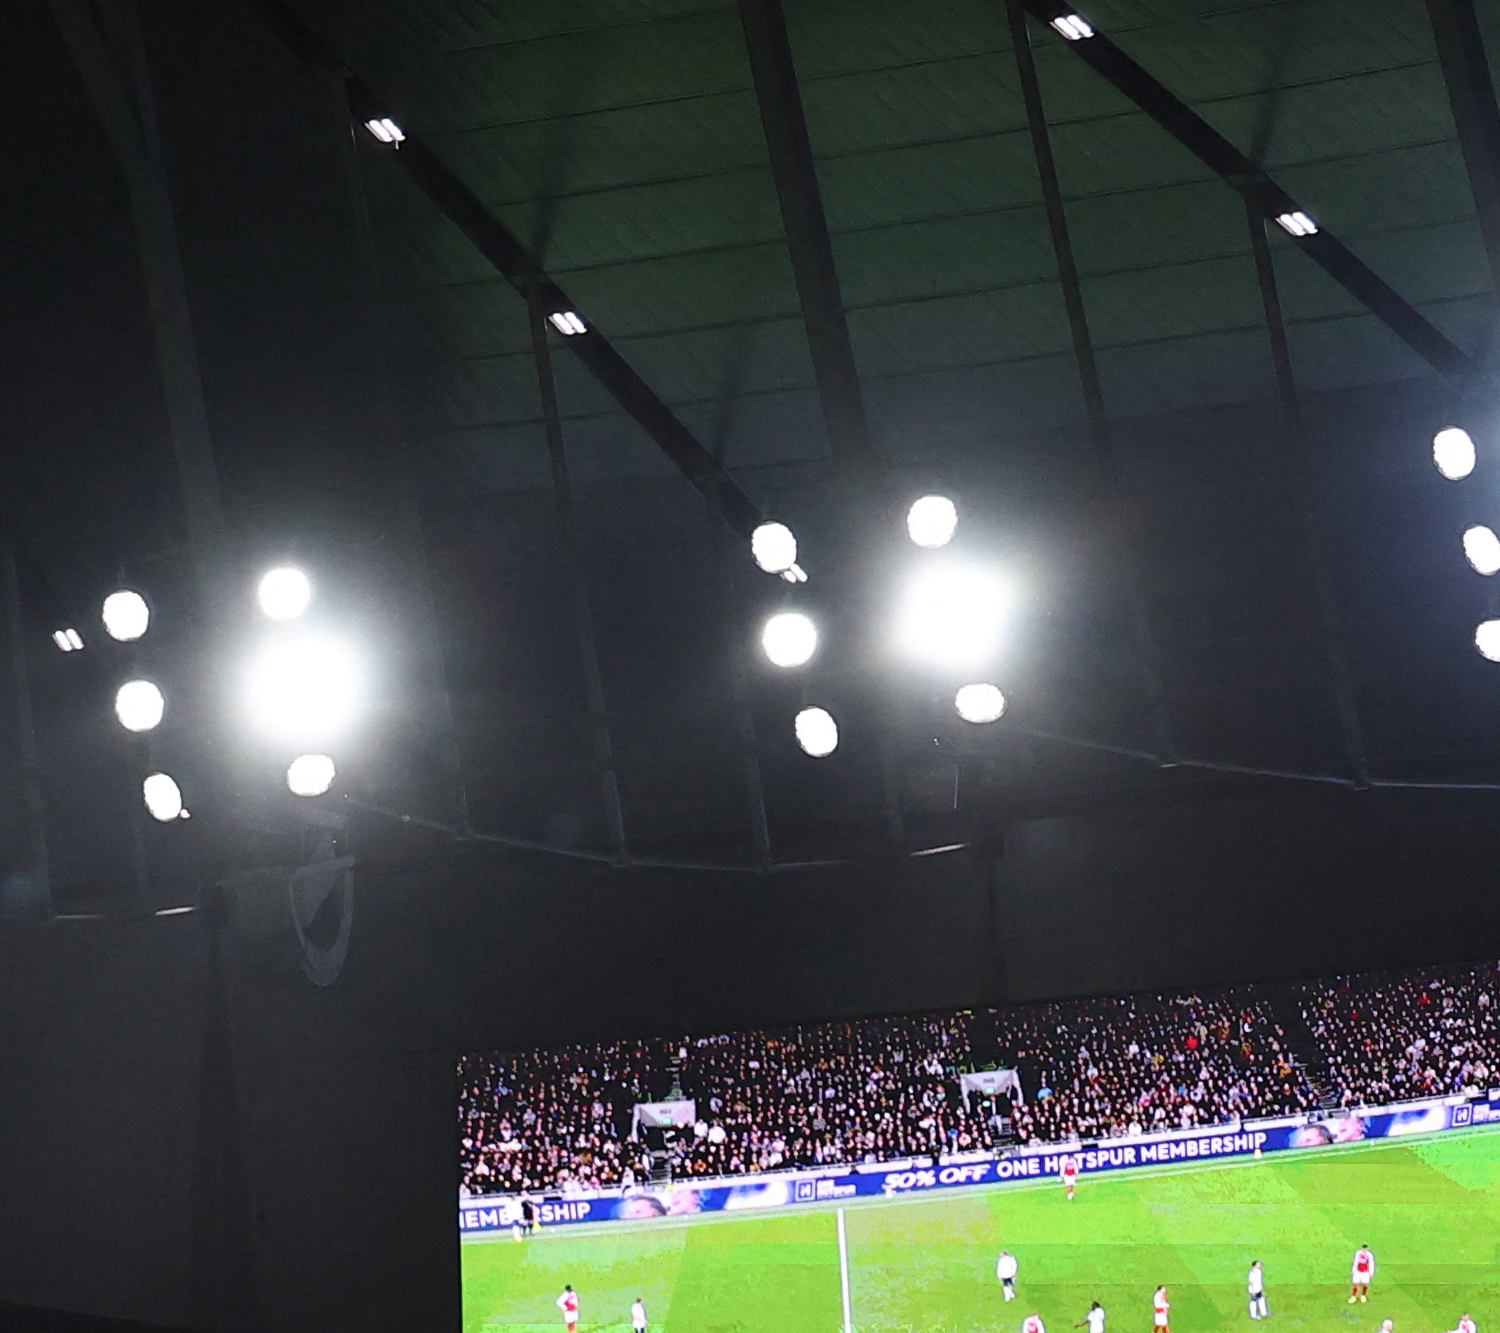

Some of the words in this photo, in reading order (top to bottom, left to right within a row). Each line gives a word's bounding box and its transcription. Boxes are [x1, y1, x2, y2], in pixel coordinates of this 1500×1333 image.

[885, 1171, 936, 1188] 50%
[939, 1165, 991, 1183] OFF
[997, 1158, 1040, 1177] ONE
[1141, 1132, 1267, 1161] MEMBERSHIP
